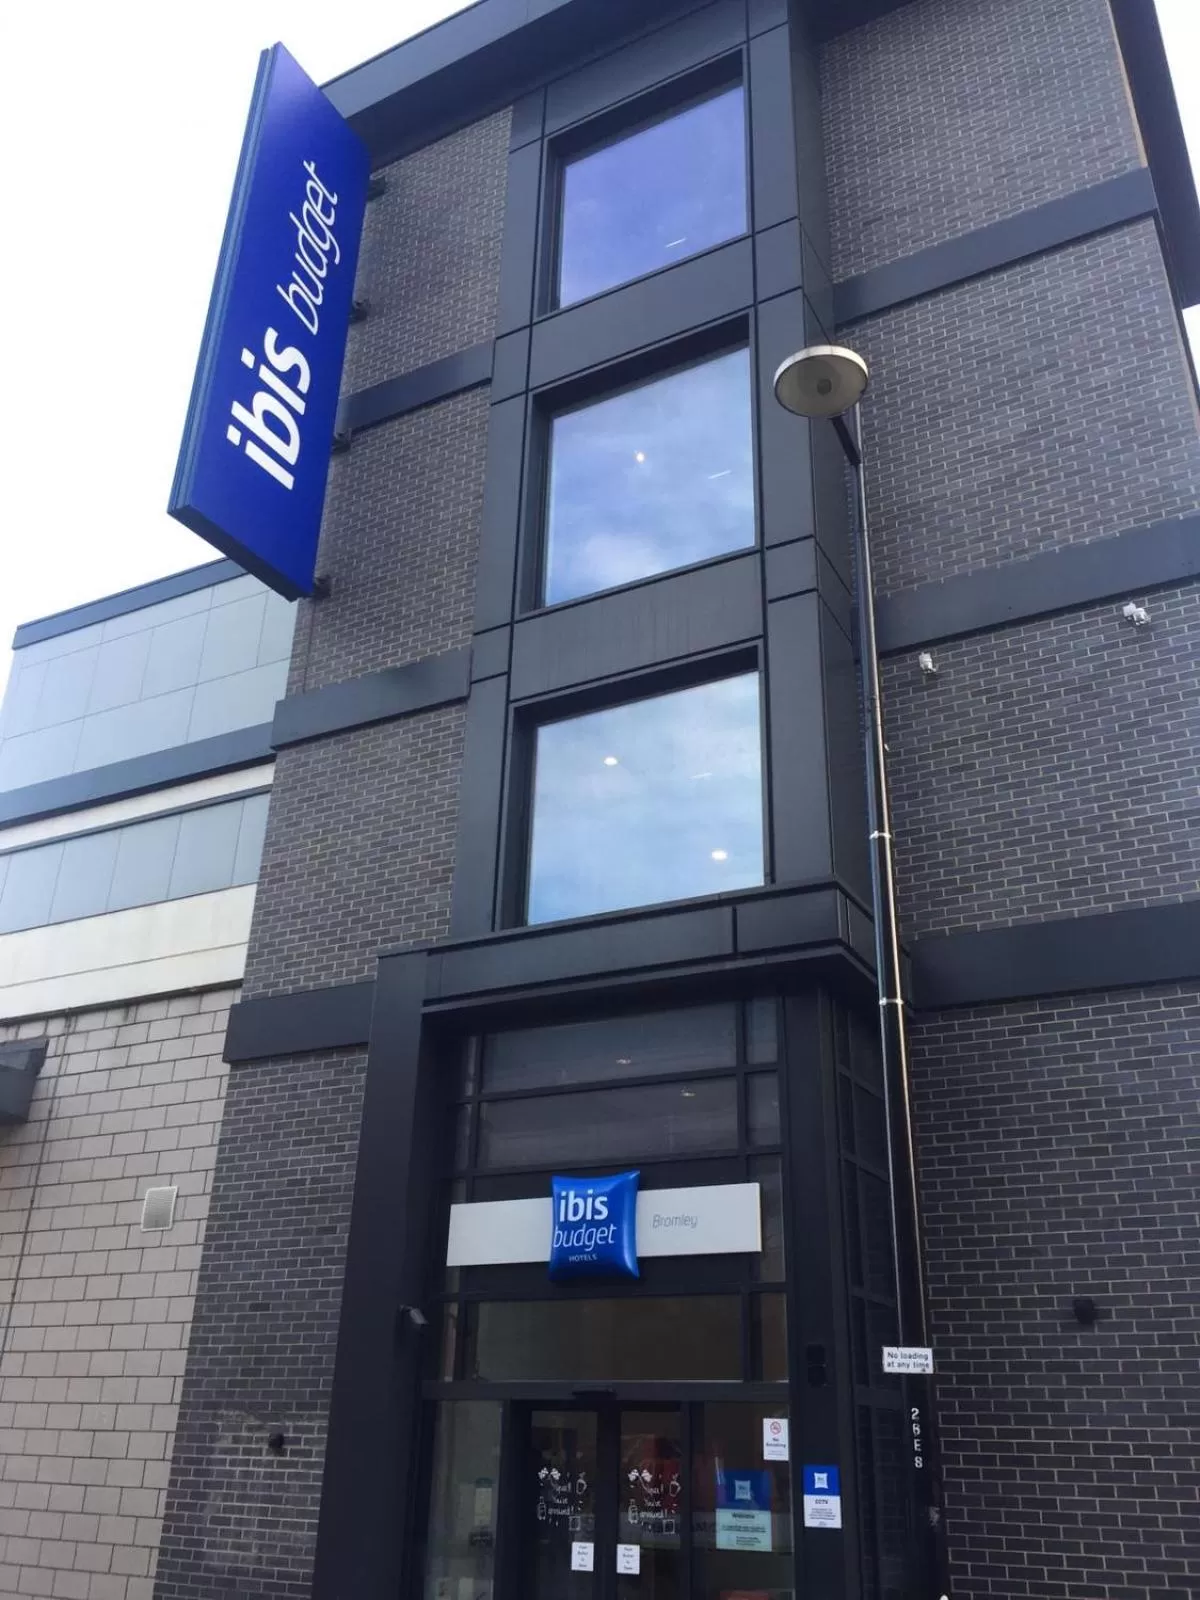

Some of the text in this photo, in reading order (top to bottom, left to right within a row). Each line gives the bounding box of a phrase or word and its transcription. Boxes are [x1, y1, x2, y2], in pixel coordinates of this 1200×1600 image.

[226, 160, 340, 490] ibis budget
[559, 1189, 609, 1222] ibis
[652, 1213, 698, 1229] Bromley
[553, 1223, 617, 1251] budget
[568, 1253, 598, 1263] HOTELS
[887, 1351, 929, 1361] No loading
[897, 1362, 911, 1370] any
[913, 1361, 930, 1369] time
